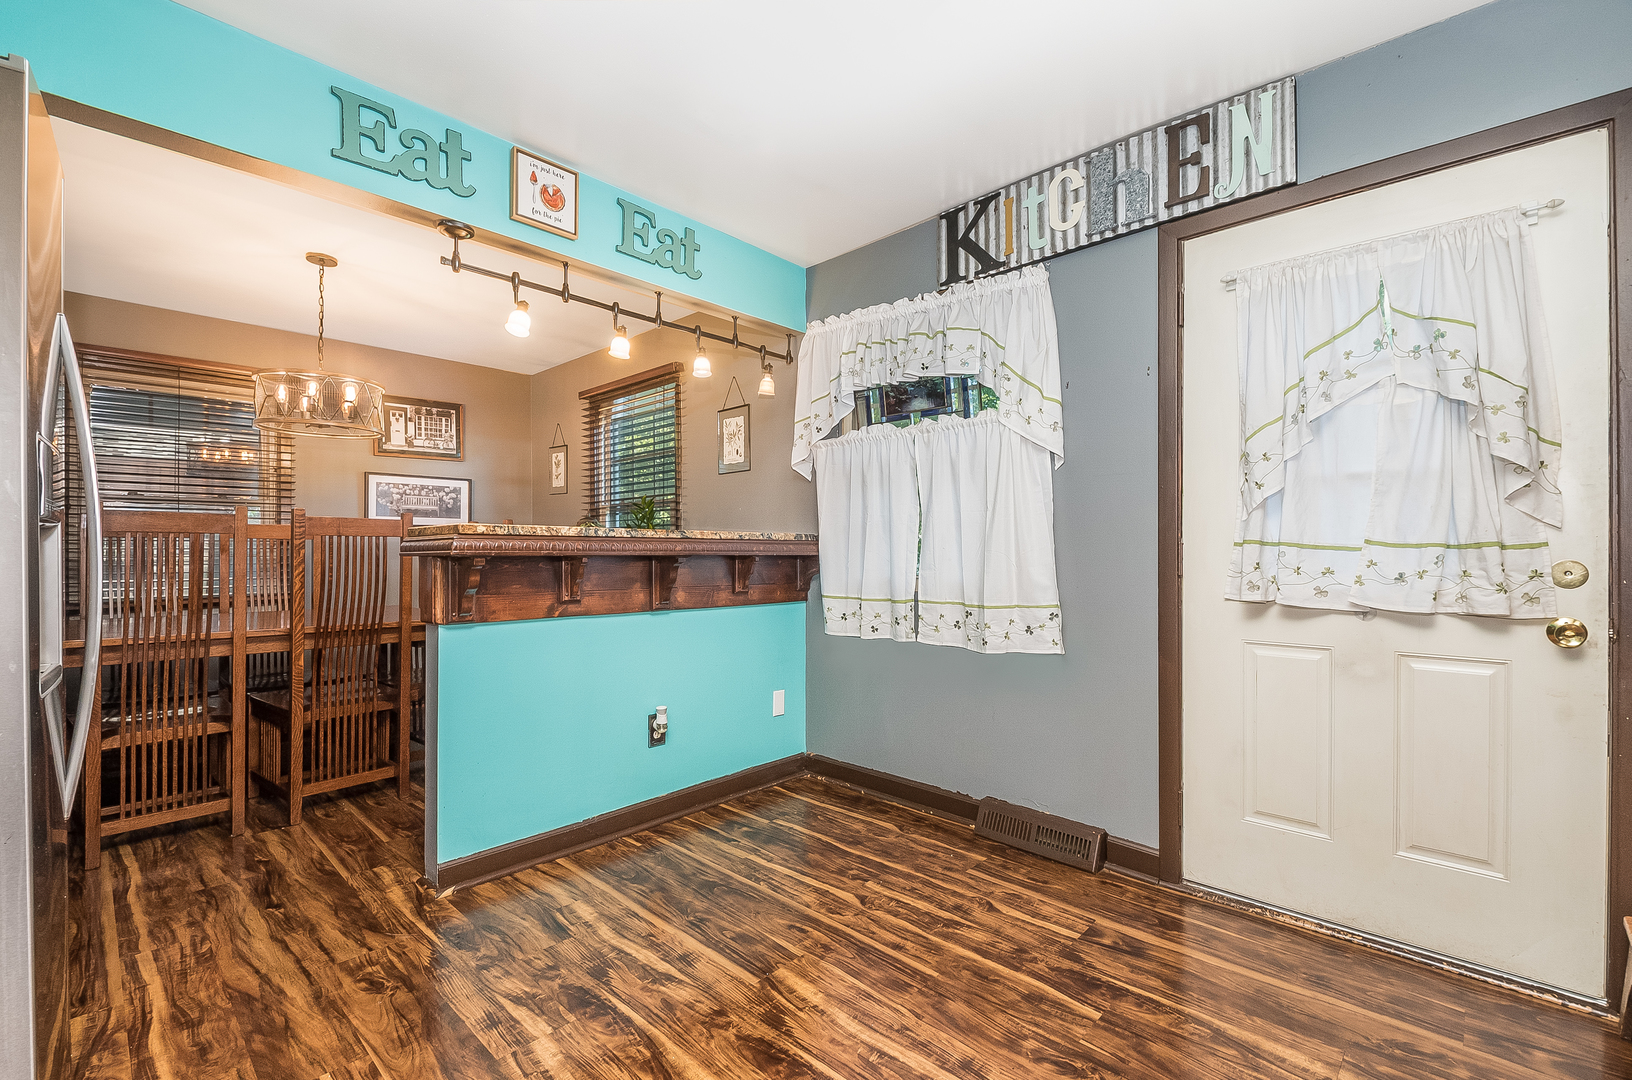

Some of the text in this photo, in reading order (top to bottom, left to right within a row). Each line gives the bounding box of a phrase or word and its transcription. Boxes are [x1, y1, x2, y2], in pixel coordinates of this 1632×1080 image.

[330, 85, 476, 198] Eat
[540, 165, 551, 175] just
[553, 169, 565, 180] here
[531, 207, 542, 216] for
[543, 211, 552, 220] the
[615, 197, 702, 280] Eat
